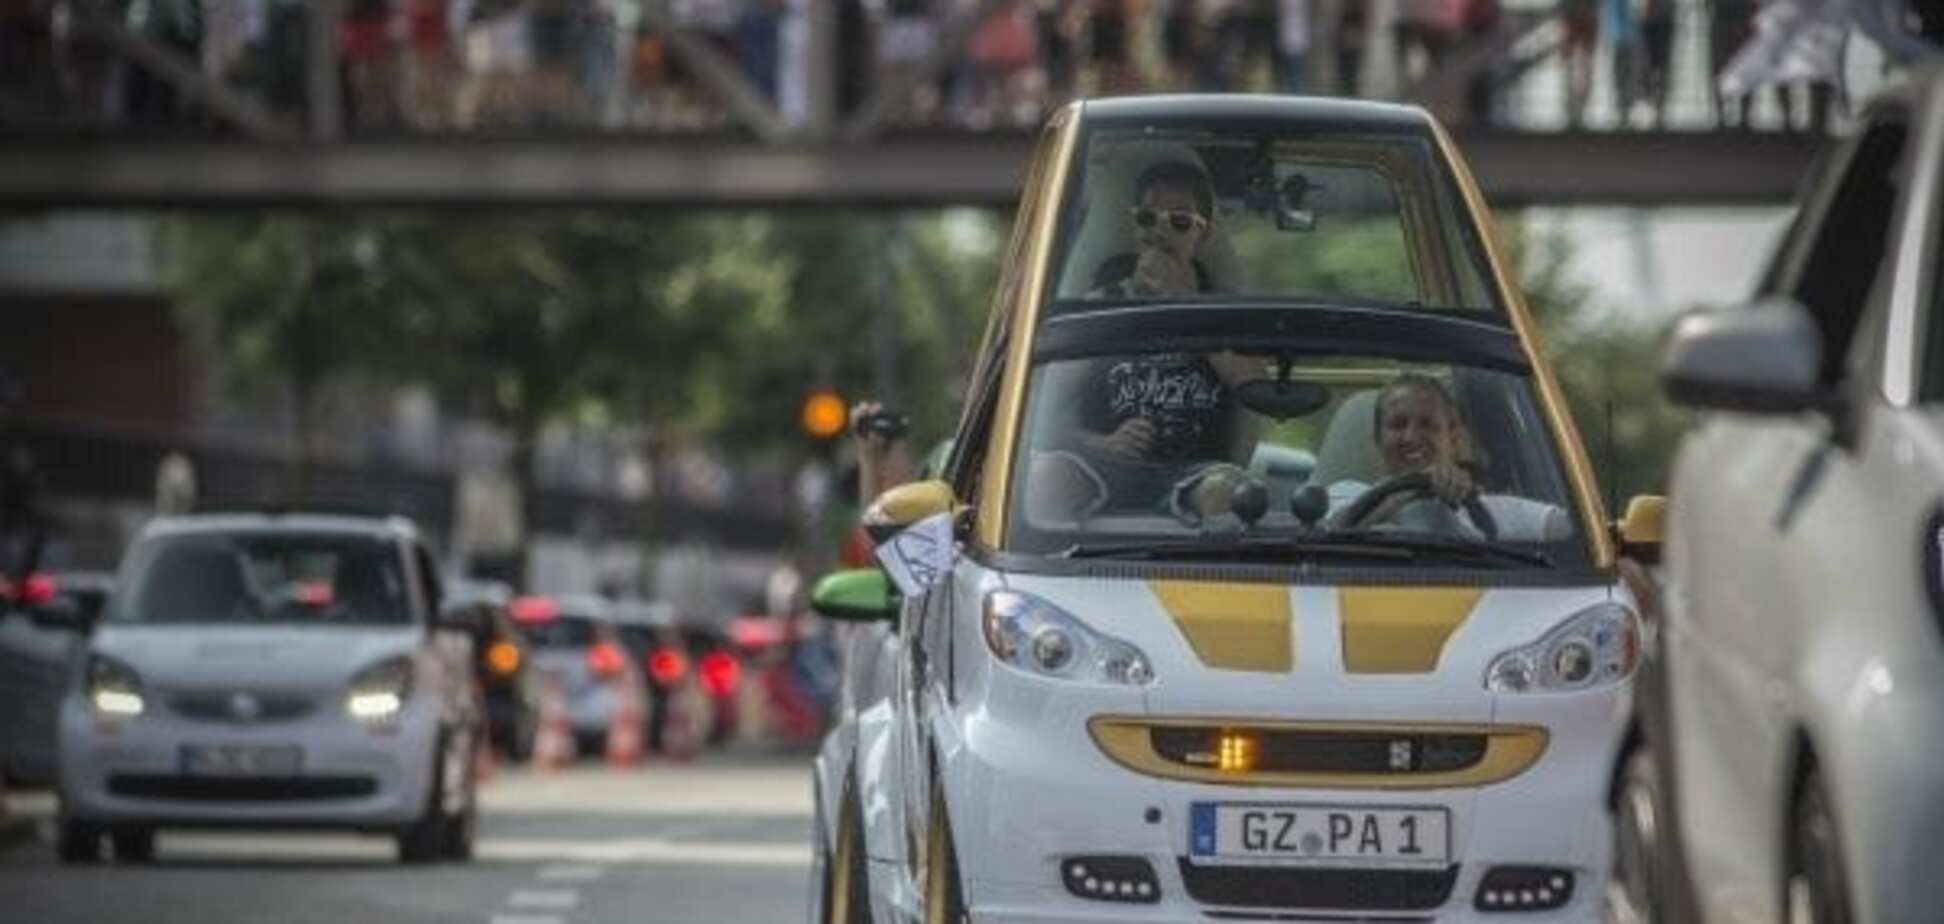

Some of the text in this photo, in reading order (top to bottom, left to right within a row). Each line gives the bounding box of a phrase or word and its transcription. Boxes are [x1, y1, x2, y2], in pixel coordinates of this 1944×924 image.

[1241, 812, 1422, 854] GZ PA 1
